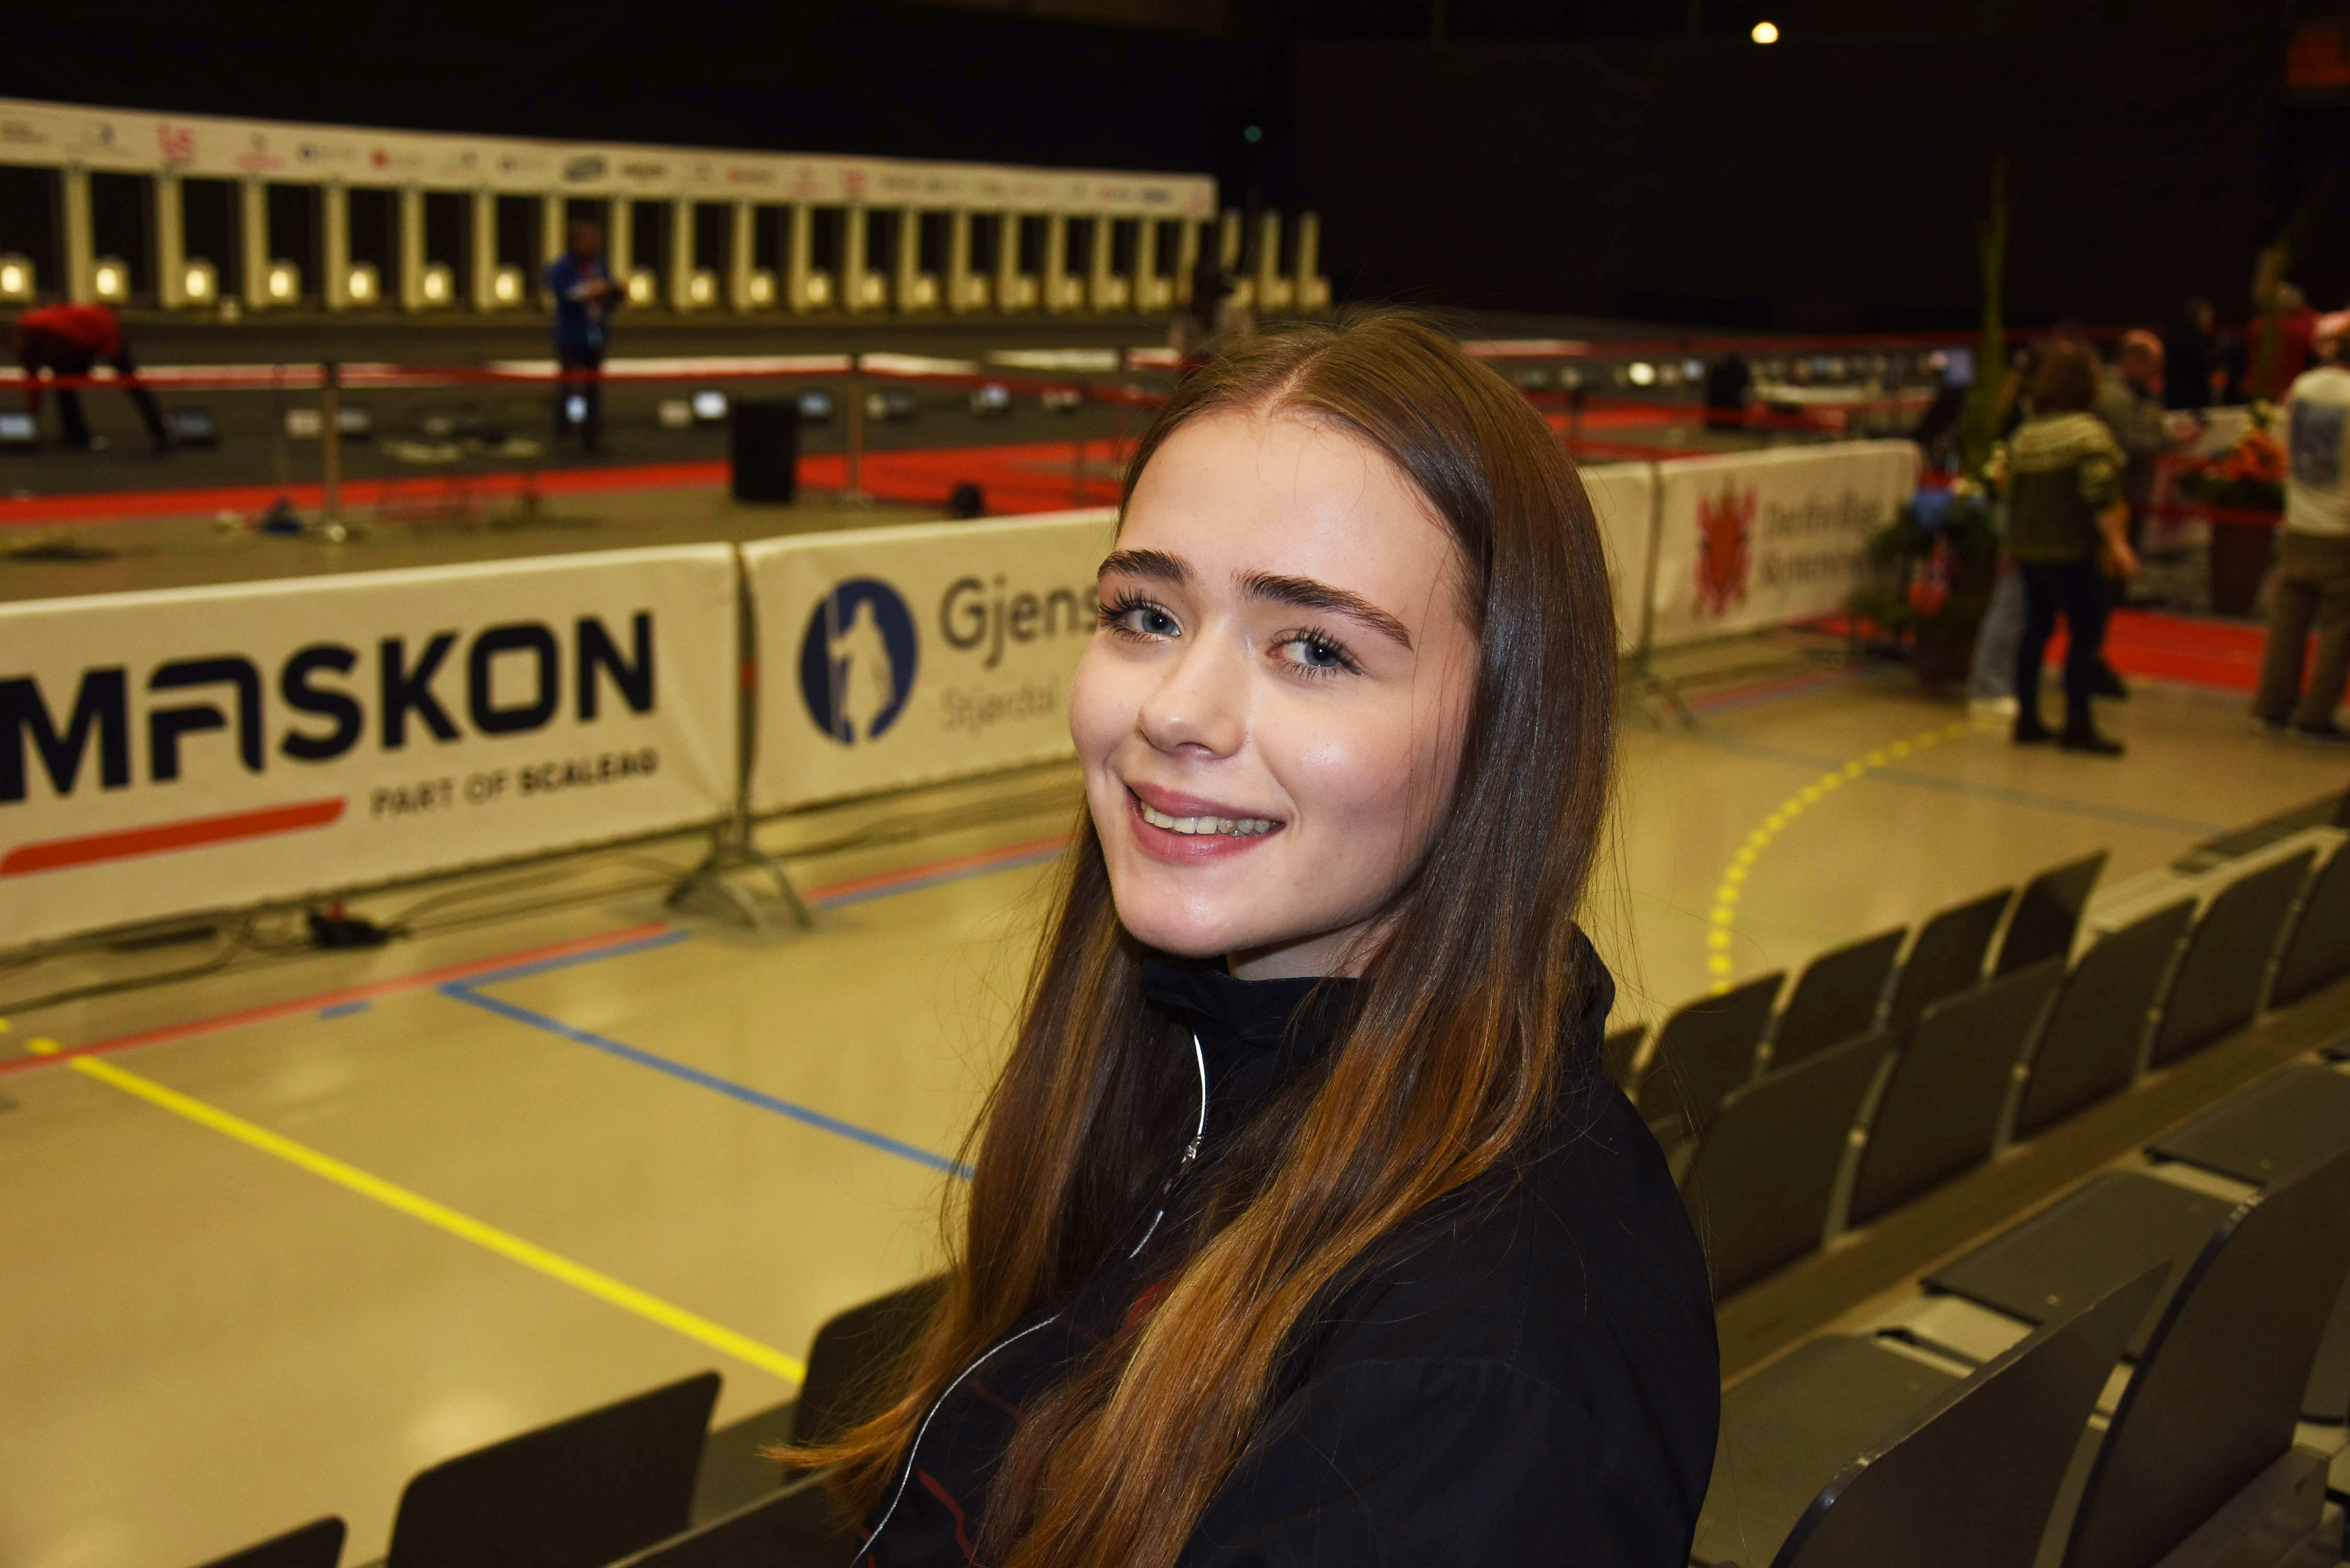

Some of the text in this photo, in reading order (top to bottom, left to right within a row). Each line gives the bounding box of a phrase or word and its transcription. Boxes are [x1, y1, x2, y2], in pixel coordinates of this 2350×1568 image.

[0, 610, 656, 804] MASKON
[371, 778, 453, 821] PART
[464, 768, 507, 805] OF
